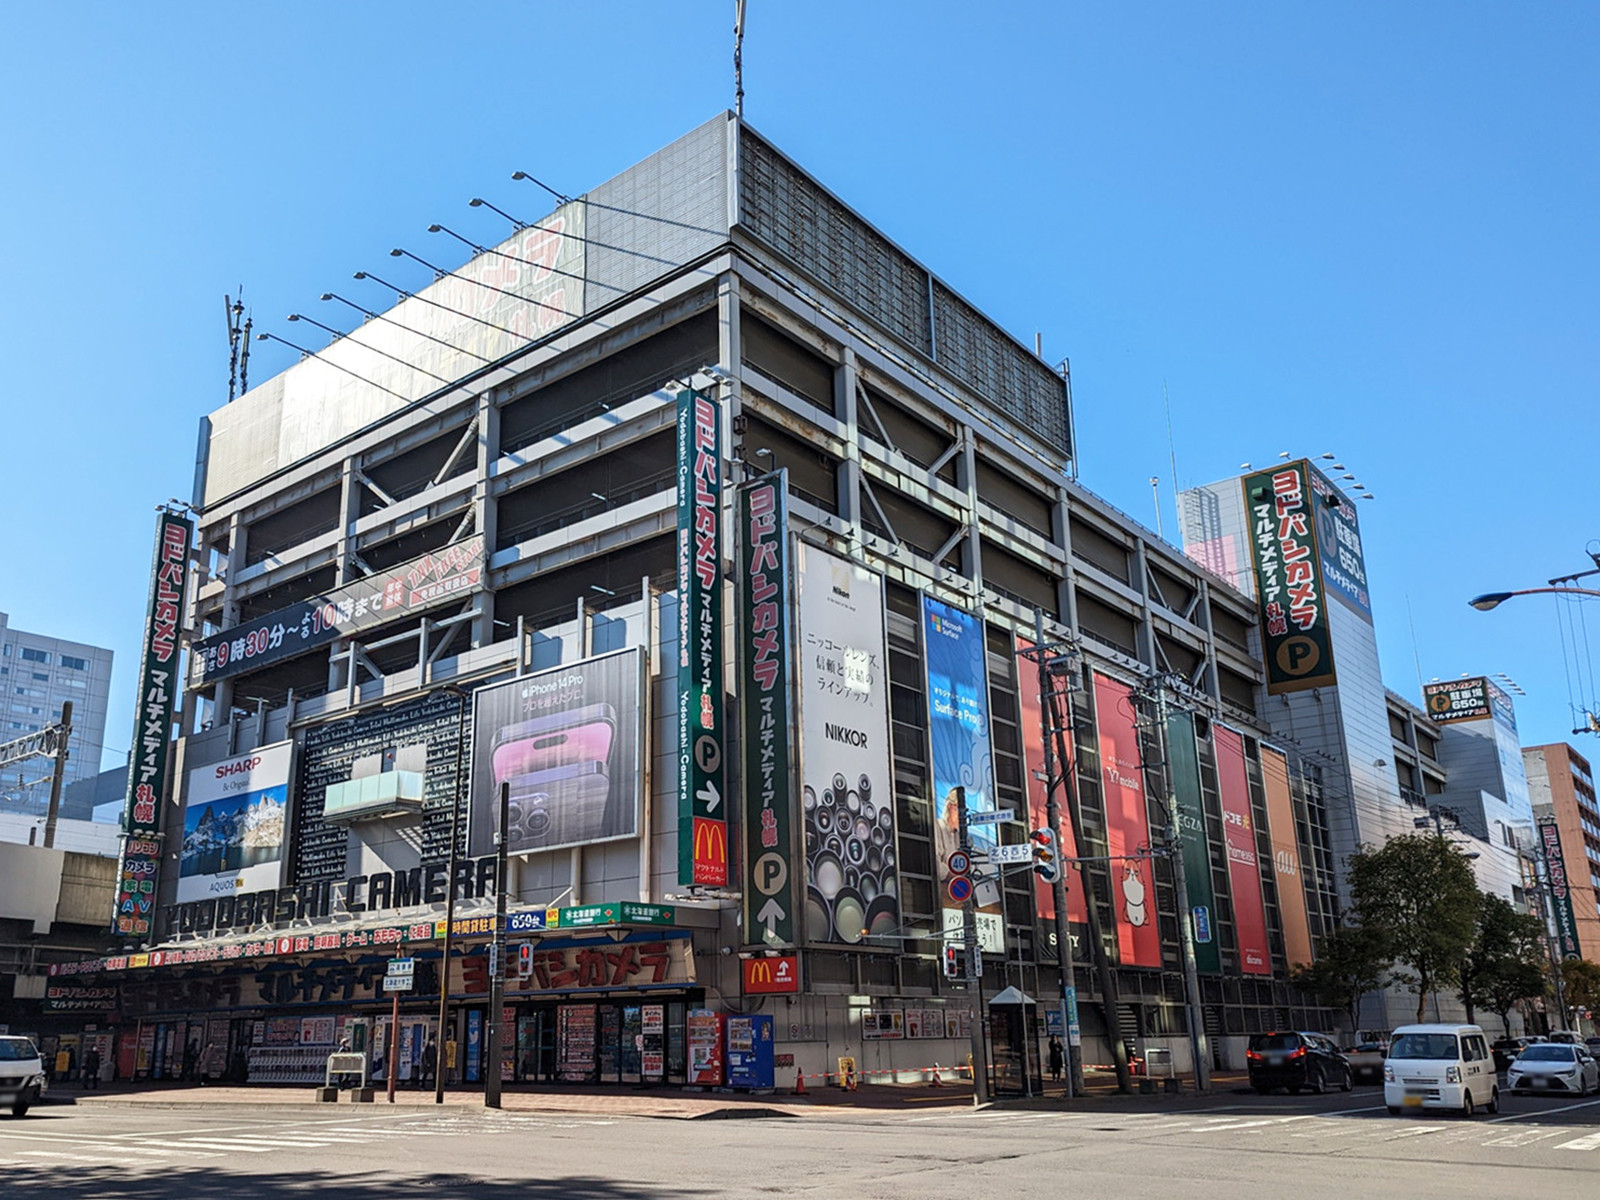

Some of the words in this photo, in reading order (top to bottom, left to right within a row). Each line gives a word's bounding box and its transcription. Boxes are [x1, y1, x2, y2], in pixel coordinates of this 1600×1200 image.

[694, 396, 717, 591] ヨドバシカメラ
[1272, 469, 1318, 631] ヨドバシカメラ
[1253, 503, 1287, 637] マルチメディア札幌
[151, 523, 187, 662] ヨドバシカメラ
[750, 484, 779, 691] ヨドバシカメラ
[832, 586, 850, 599] Nikon
[942, 618, 963, 634] Microsoft
[700, 592, 716, 730] マルチメディア札幌
[816, 655, 874, 686] 信頼と実績の
[529, 682, 557, 698] iPhone
[558, 679, 568, 691] 14
[570, 675, 584, 688] Pro
[817, 678, 874, 708] ラインアップ。
[1450, 688, 1483, 701] 駐車場
[134, 668, 169, 824] マルチメディア札幌
[680, 690, 690, 801] Yodobashi-Camera
[825, 723, 868, 749] NIKKOR
[215, 756, 262, 779] SHARP
[759, 696, 779, 848] マルチメディア札幌
[127, 841, 159, 856] パソコン
[126, 860, 157, 874] カメラ
[953, 858, 965, 869] 40
[163, 879, 332, 937] YODOBASHI
[346, 856, 497, 914] CAMERA
[209, 879, 234, 892] AQUOS
[452, 917, 497, 936] 時間貸駐車
[512, 914, 540, 929] 650台
[1049, 932, 1079, 948] SY
